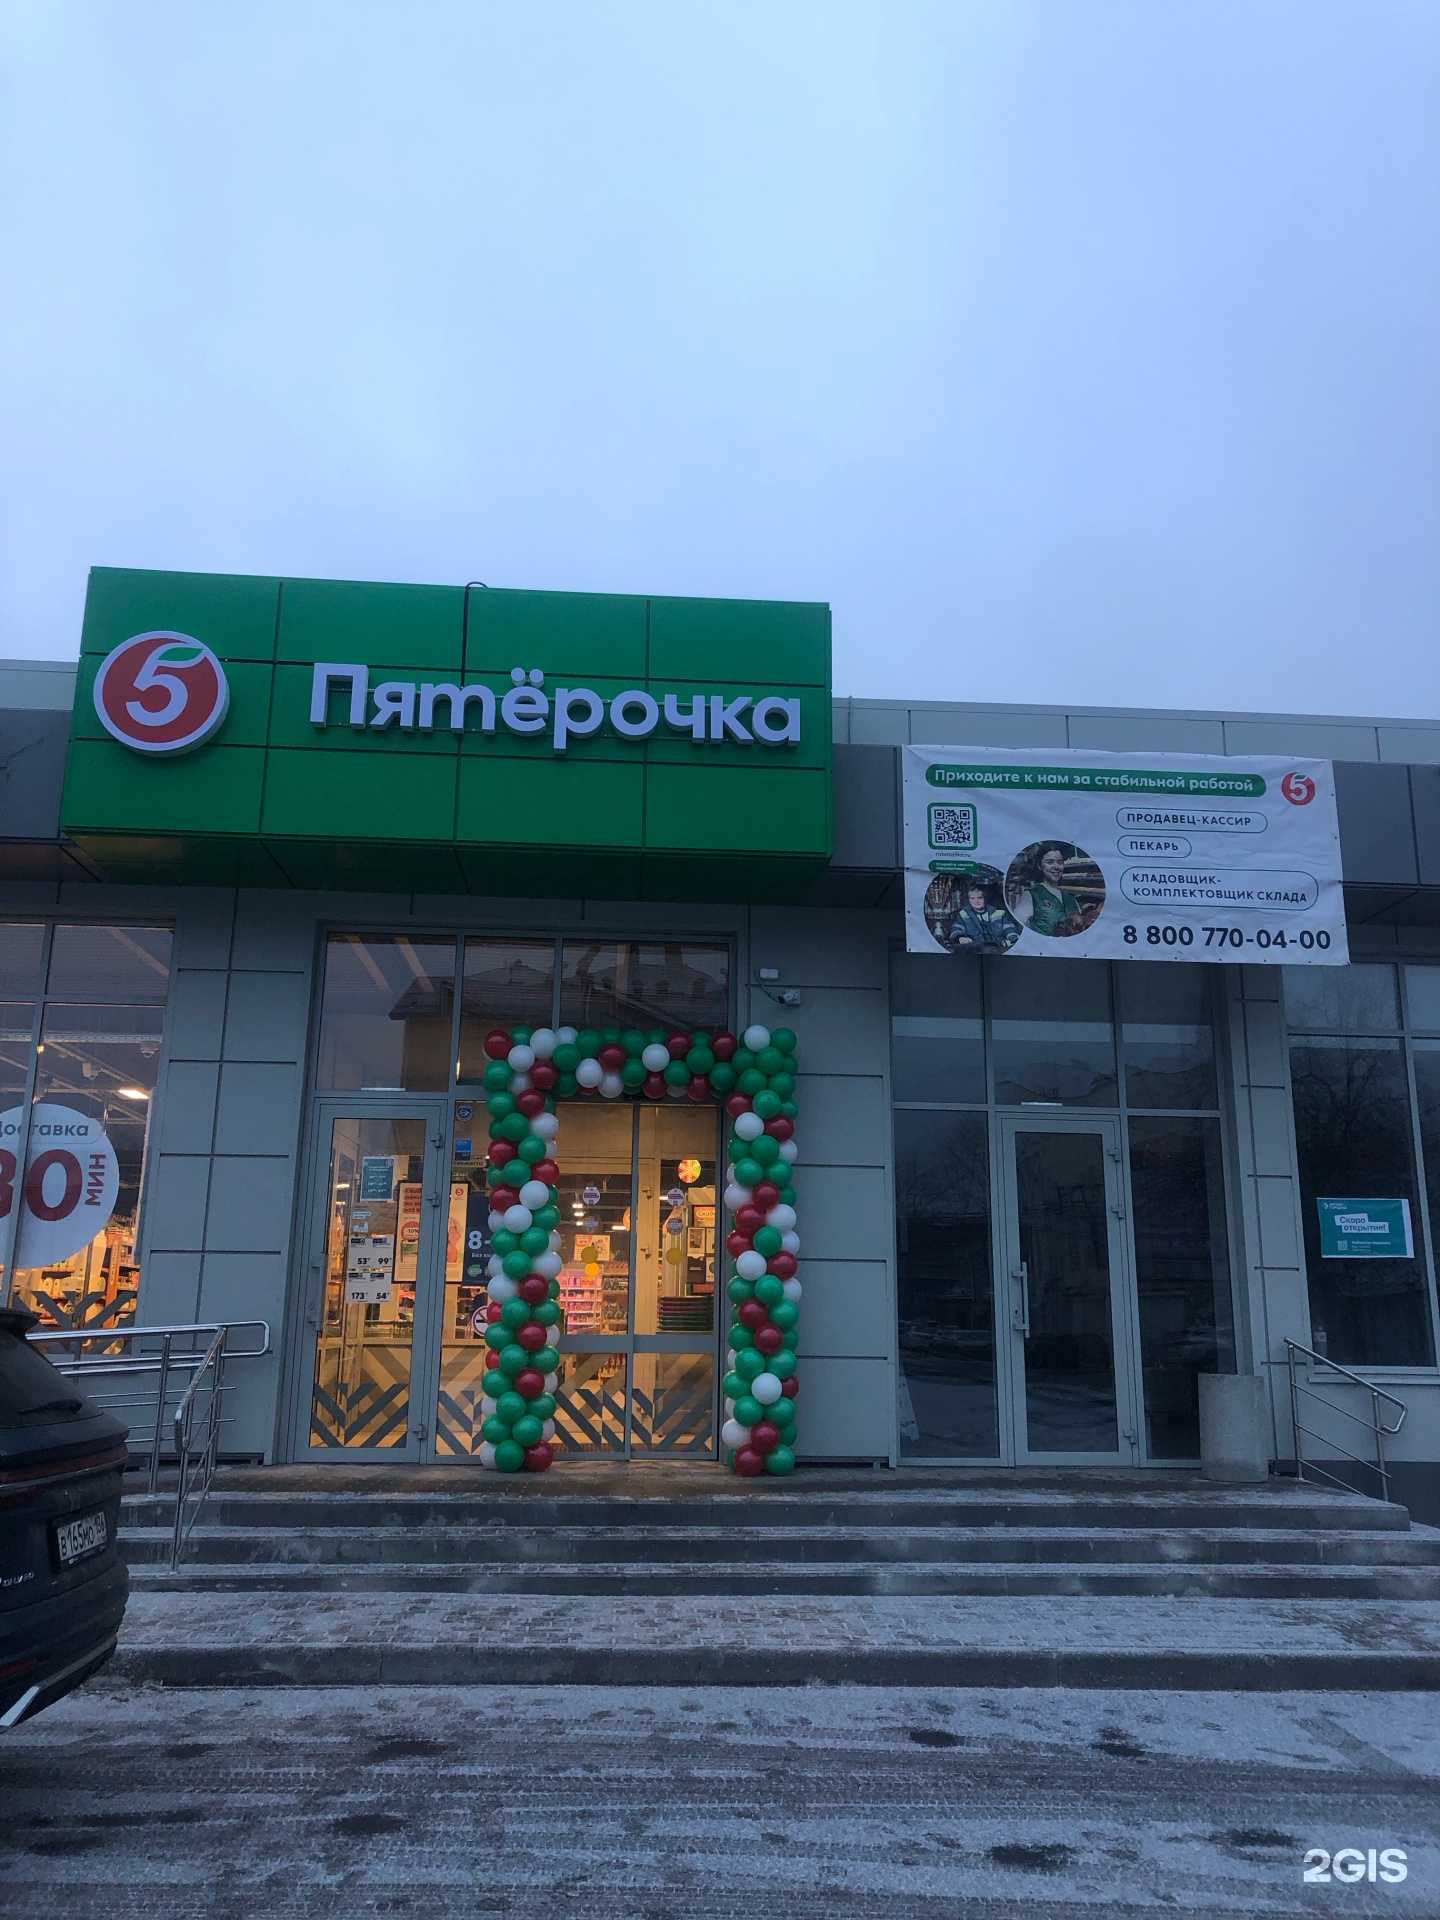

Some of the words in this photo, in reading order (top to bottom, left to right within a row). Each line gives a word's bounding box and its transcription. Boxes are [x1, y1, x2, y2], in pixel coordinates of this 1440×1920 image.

[309, 662, 801, 754] Пятёрочка
[934, 769, 1020, 784] Приходите
[1024, 773, 1033, 783] к
[1038, 774, 1069, 785] нам
[1072, 775, 1091, 786] за
[1094, 775, 1186, 788] стабильной
[1189, 777, 1254, 792] работой
[1127, 813, 1252, 828] ПРОДАВЕЦ-КАССИР
[1130, 840, 1179, 852] ПЕКАРЬ
[1132, 872, 1222, 885] КЛАДОВЩИК-
[1133, 887, 1254, 901] КОМПЛЕКТОВЩИК
[1256, 891, 1308, 904] СКЛАДА
[1123, 925, 1138, 945] 8
[1146, 925, 1194, 946] 800
[1201, 927, 1331, 950] 770-04-00
[0, 1121, 89, 1138] отавка
